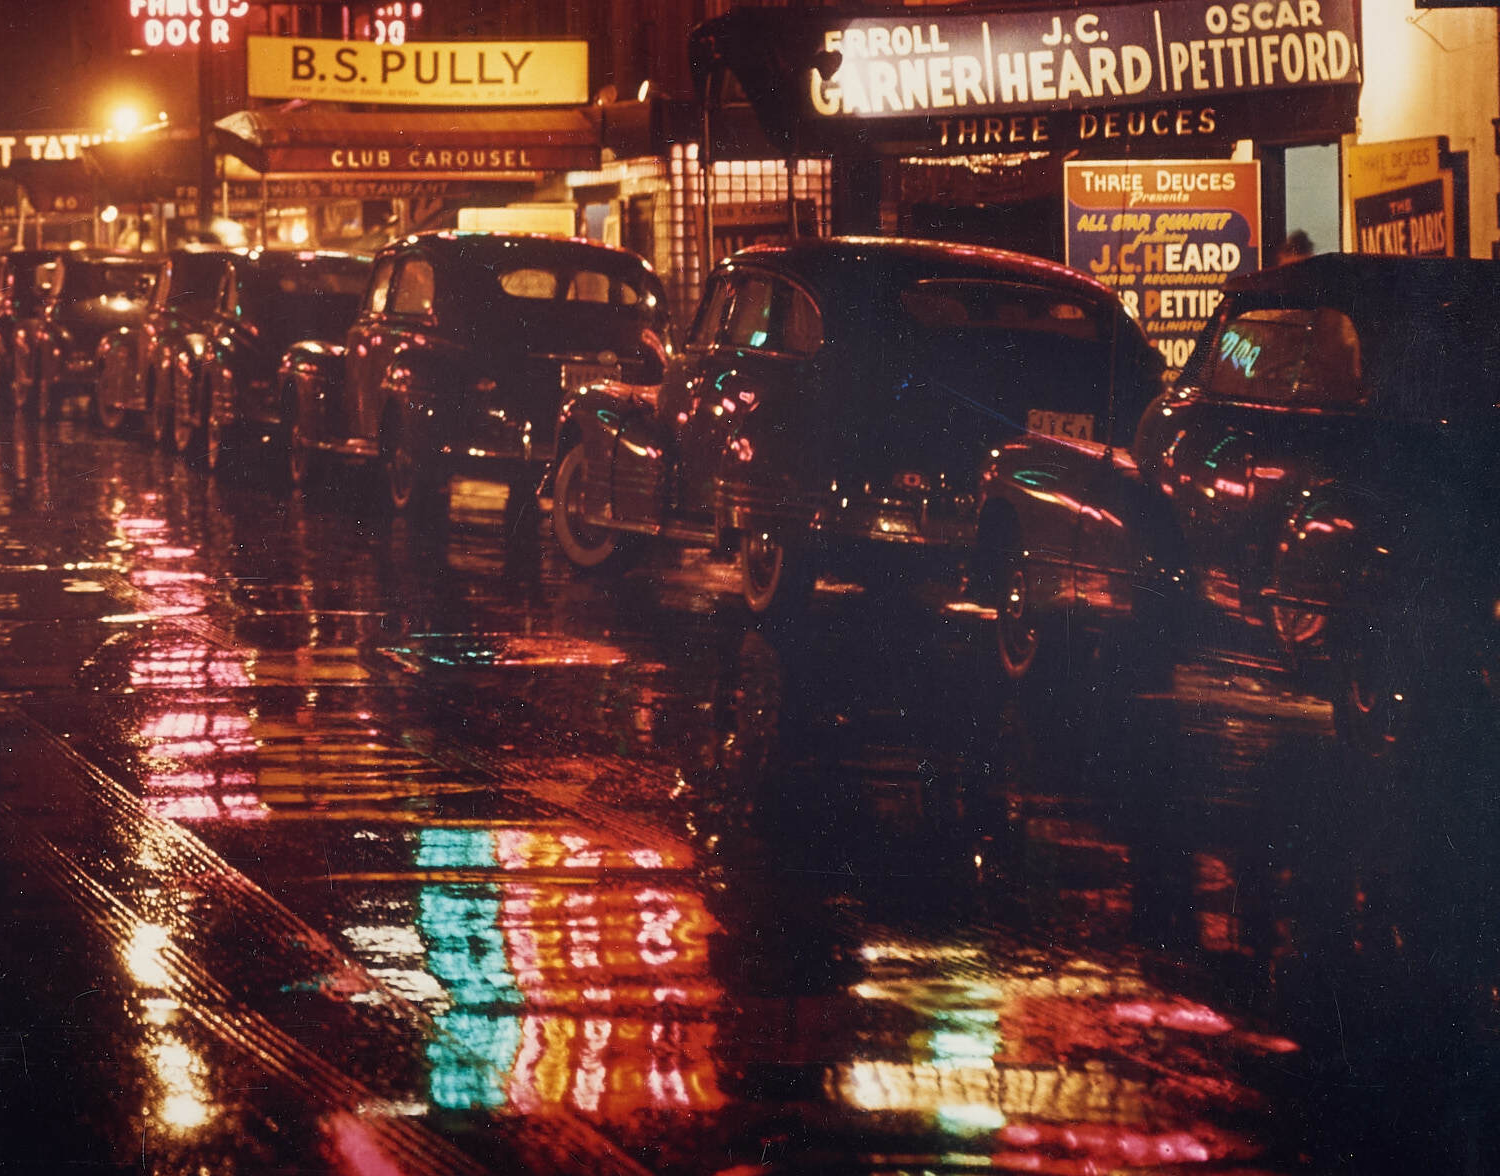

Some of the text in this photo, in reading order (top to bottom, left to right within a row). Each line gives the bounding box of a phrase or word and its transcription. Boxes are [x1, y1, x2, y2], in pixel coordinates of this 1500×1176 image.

[824, 24, 950, 58] ERROLL
[1042, 13, 1109, 45] J.C.
[291, 45, 533, 85] B.S. PULLY
[810, 29, 1352, 116] GARNER HEARD PETTIFORD
[936, 108, 1218, 147] THREE DEUCES
[331, 149, 532, 168] CLUB CAROUSEL
[1081, 170, 1236, 193] THREE DEUCES
[1077, 212, 1232, 232] ALL STAR QUARTET
[1144, 290, 1226, 319] PETTIF
